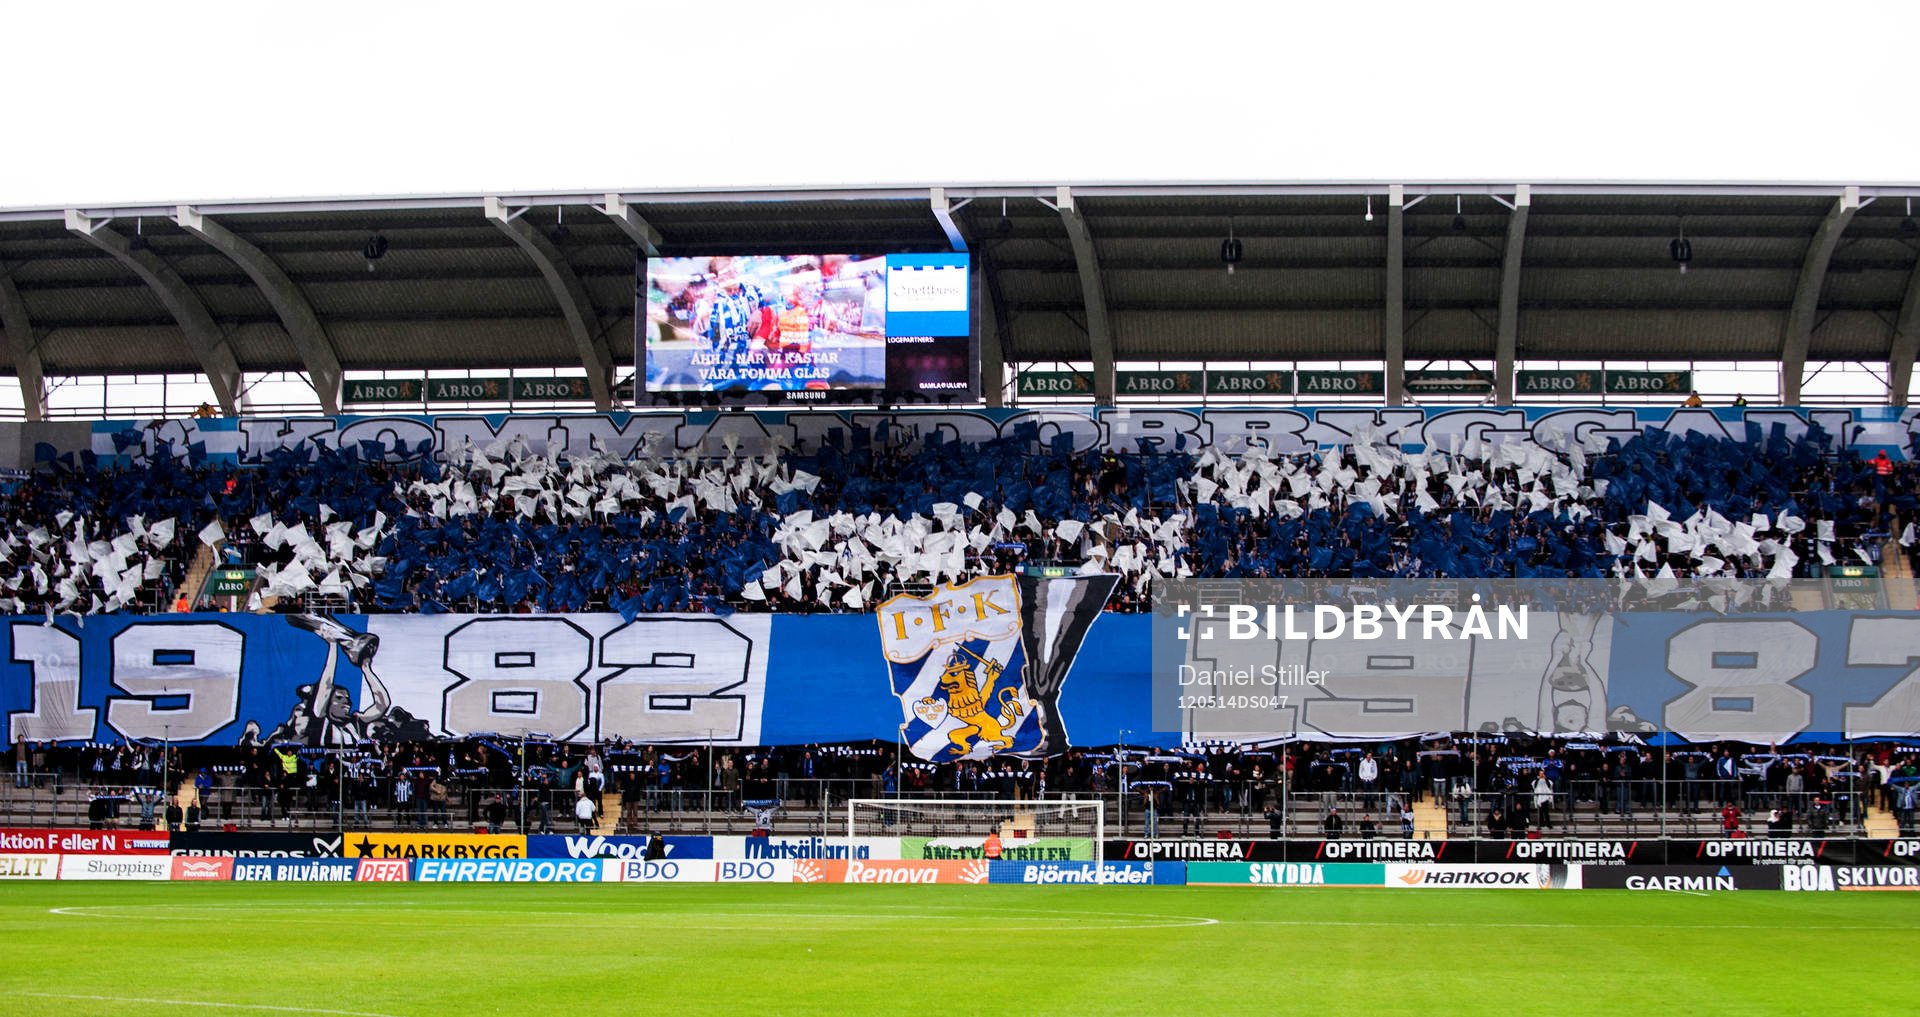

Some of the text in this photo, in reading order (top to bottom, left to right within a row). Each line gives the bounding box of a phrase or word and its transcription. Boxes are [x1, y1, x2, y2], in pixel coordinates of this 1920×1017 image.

[766, 353, 782, 364] VI
[784, 351, 838, 364] KASTAR
[739, 367, 791, 379] TOMMA
[794, 367, 830, 379] GLAS
[786, 392, 827, 400] SAMSUNG
[10, 617, 753, 744] 19 82
[48, 834, 59, 849] F
[61, 835, 99, 850] eller
[102, 835, 116, 850] N
[1134, 842, 1244, 858] OPTIMERA
[1325, 842, 1435, 858] OPTIMERA
[1516, 842, 1626, 858] OPTIMERA
[1706, 841, 1814, 857] OPTIMERA
[383, 844, 519, 858] MARKBYGG
[87, 859, 162, 877] Shopping
[235, 861, 353, 881] DEFA BILVÄRME
[362, 864, 406, 881] DEFA
[418, 861, 597, 882] EHRENBORG
[628, 861, 679, 880] BDO
[722, 861, 775, 880] BDO
[843, 863, 939, 884] Renova
[1023, 864, 1152, 885] Björnkäder
[1249, 863, 1324, 884] SKYDDA
[1784, 865, 1918, 891] BOA SKIVOR
